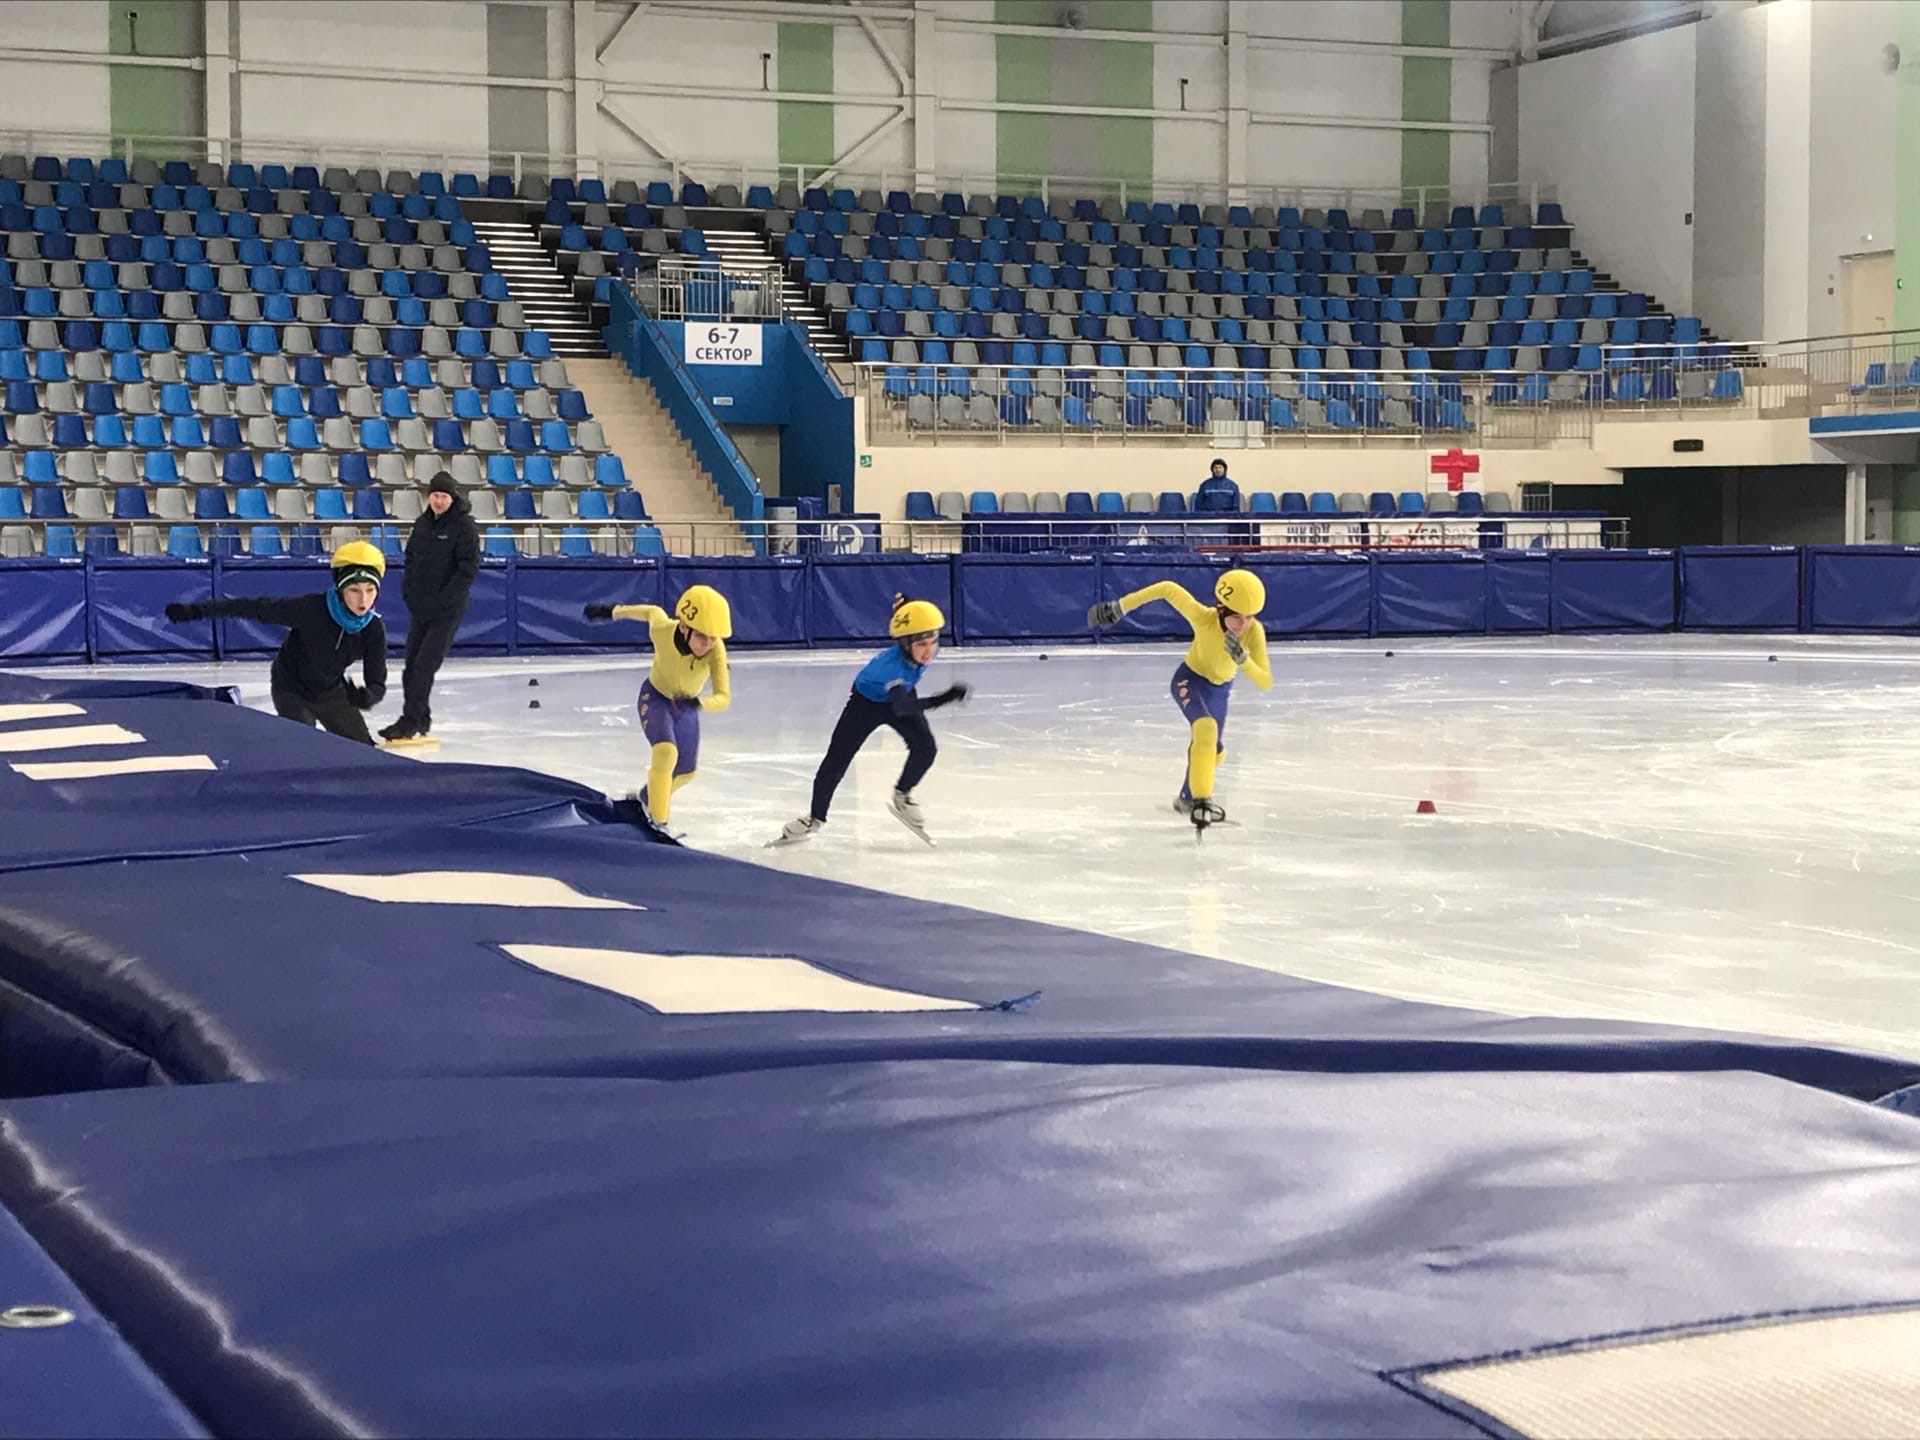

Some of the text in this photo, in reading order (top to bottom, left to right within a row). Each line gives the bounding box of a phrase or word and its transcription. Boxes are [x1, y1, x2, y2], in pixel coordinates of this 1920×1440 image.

[708, 327, 739, 344] 6-7
[695, 347, 752, 360] СЕКТОР
[1218, 580, 1234, 601] 22
[680, 599, 698, 621] 23
